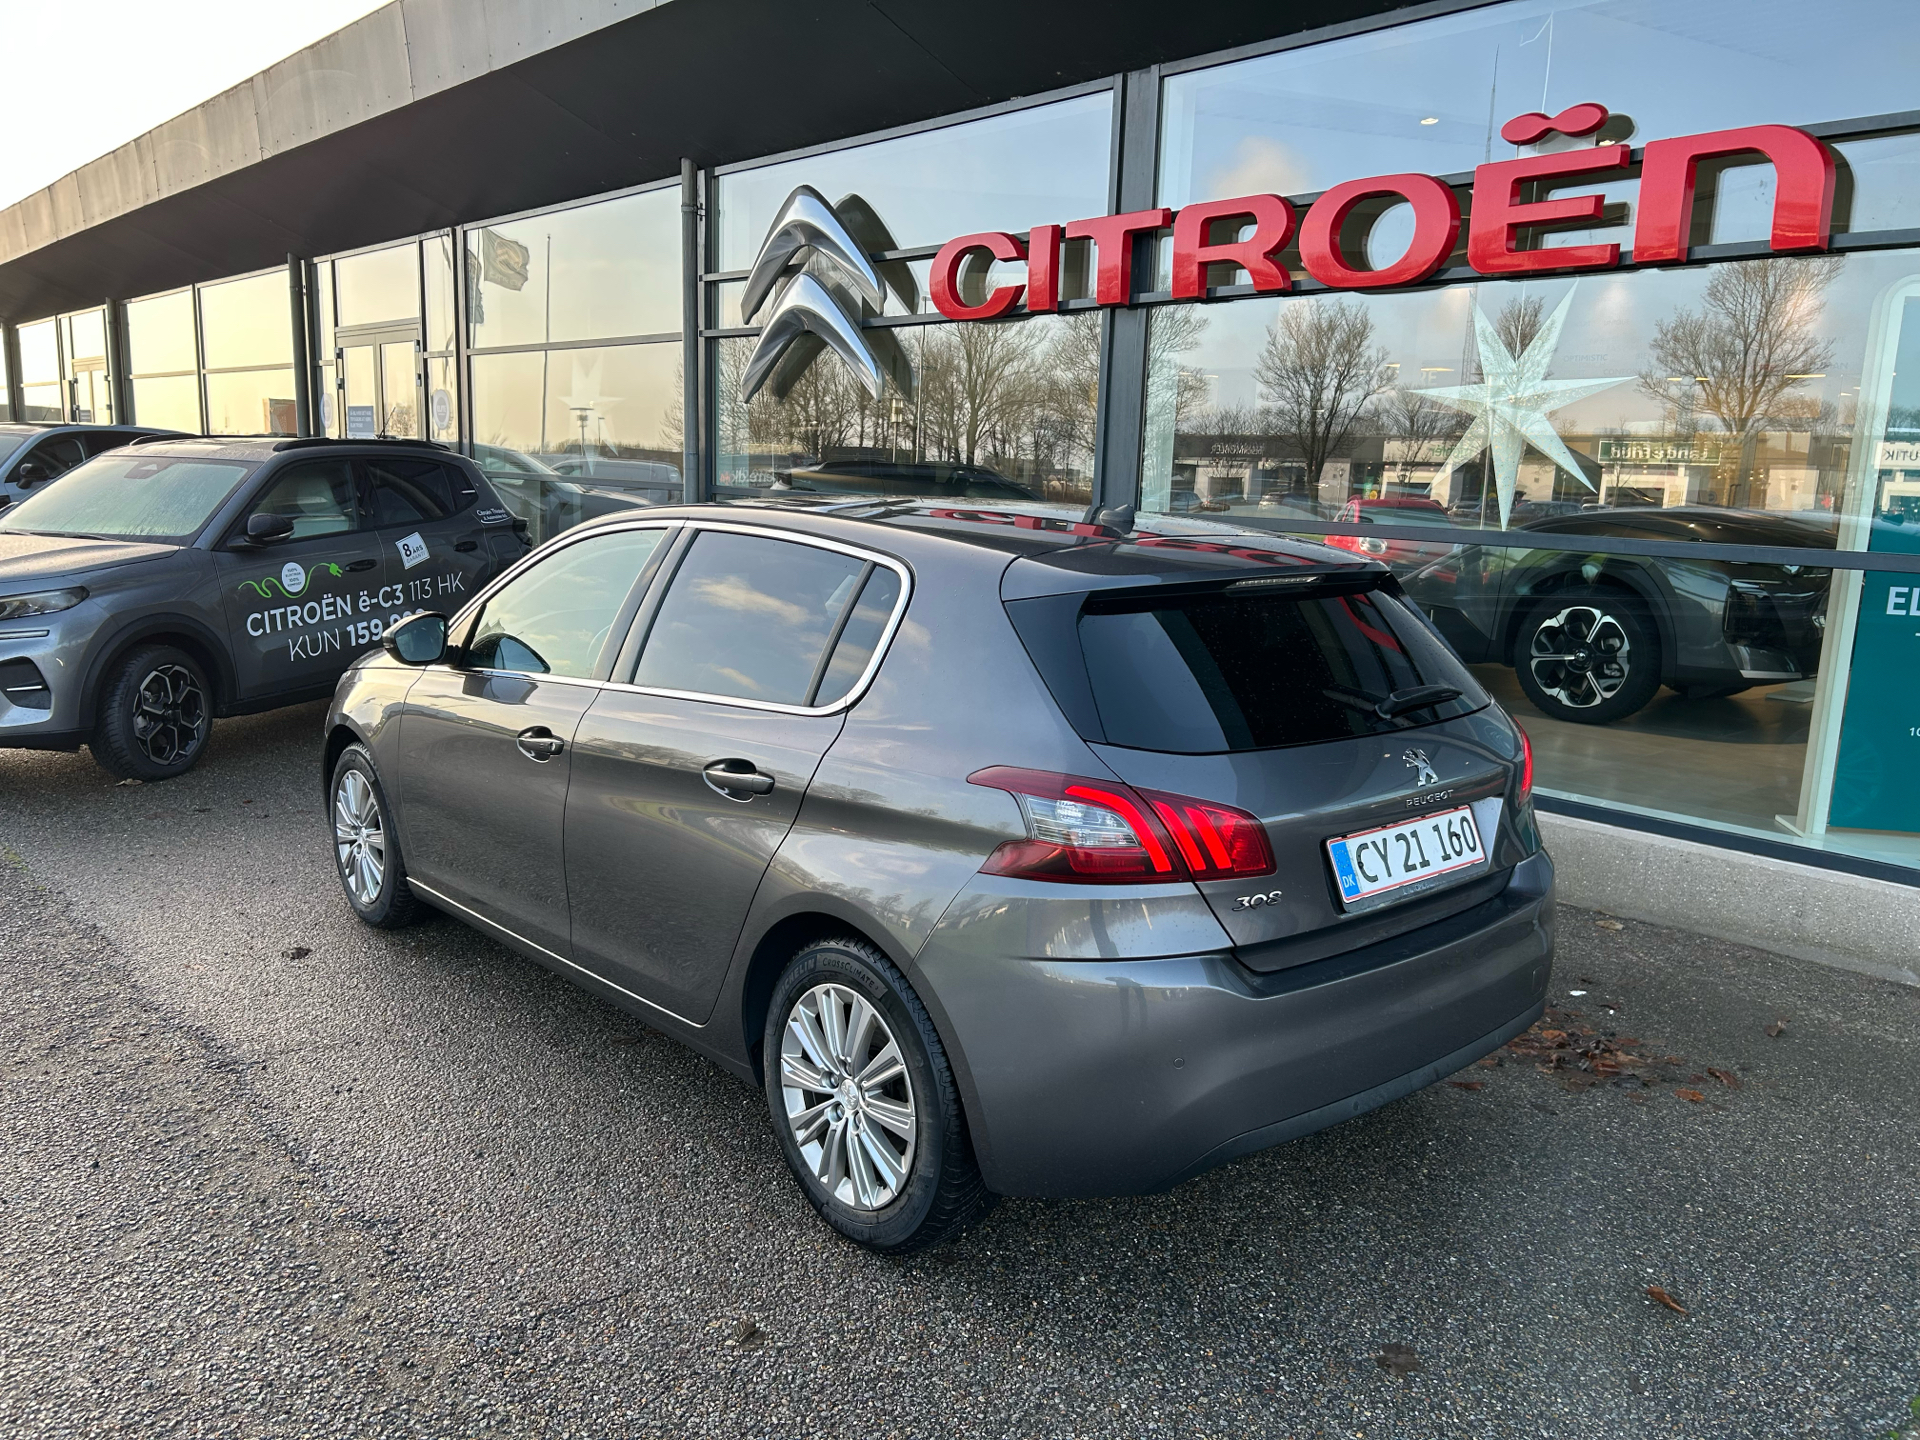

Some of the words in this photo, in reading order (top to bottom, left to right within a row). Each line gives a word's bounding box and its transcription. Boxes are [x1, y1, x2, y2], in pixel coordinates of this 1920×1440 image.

[928, 102, 1837, 322] CITROËN
[1563, 353, 1608, 362] OPTIMISTIC
[402, 543, 412, 558] 8
[246, 593, 352, 637] CITROËN
[358, 583, 404, 613] ë-C3
[408, 577, 432, 601] 113
[437, 571, 465, 596] HK
[288, 627, 341, 662] KUN
[1406, 788, 1454, 809] PEUGEOT
[1355, 836, 1393, 883] CY
[1395, 829, 1431, 873] 21
[1431, 815, 1478, 862] 160
[1342, 875, 1356, 888] DK
[1231, 889, 1283, 912] 308
[775, 957, 815, 1002] MICHELIN
